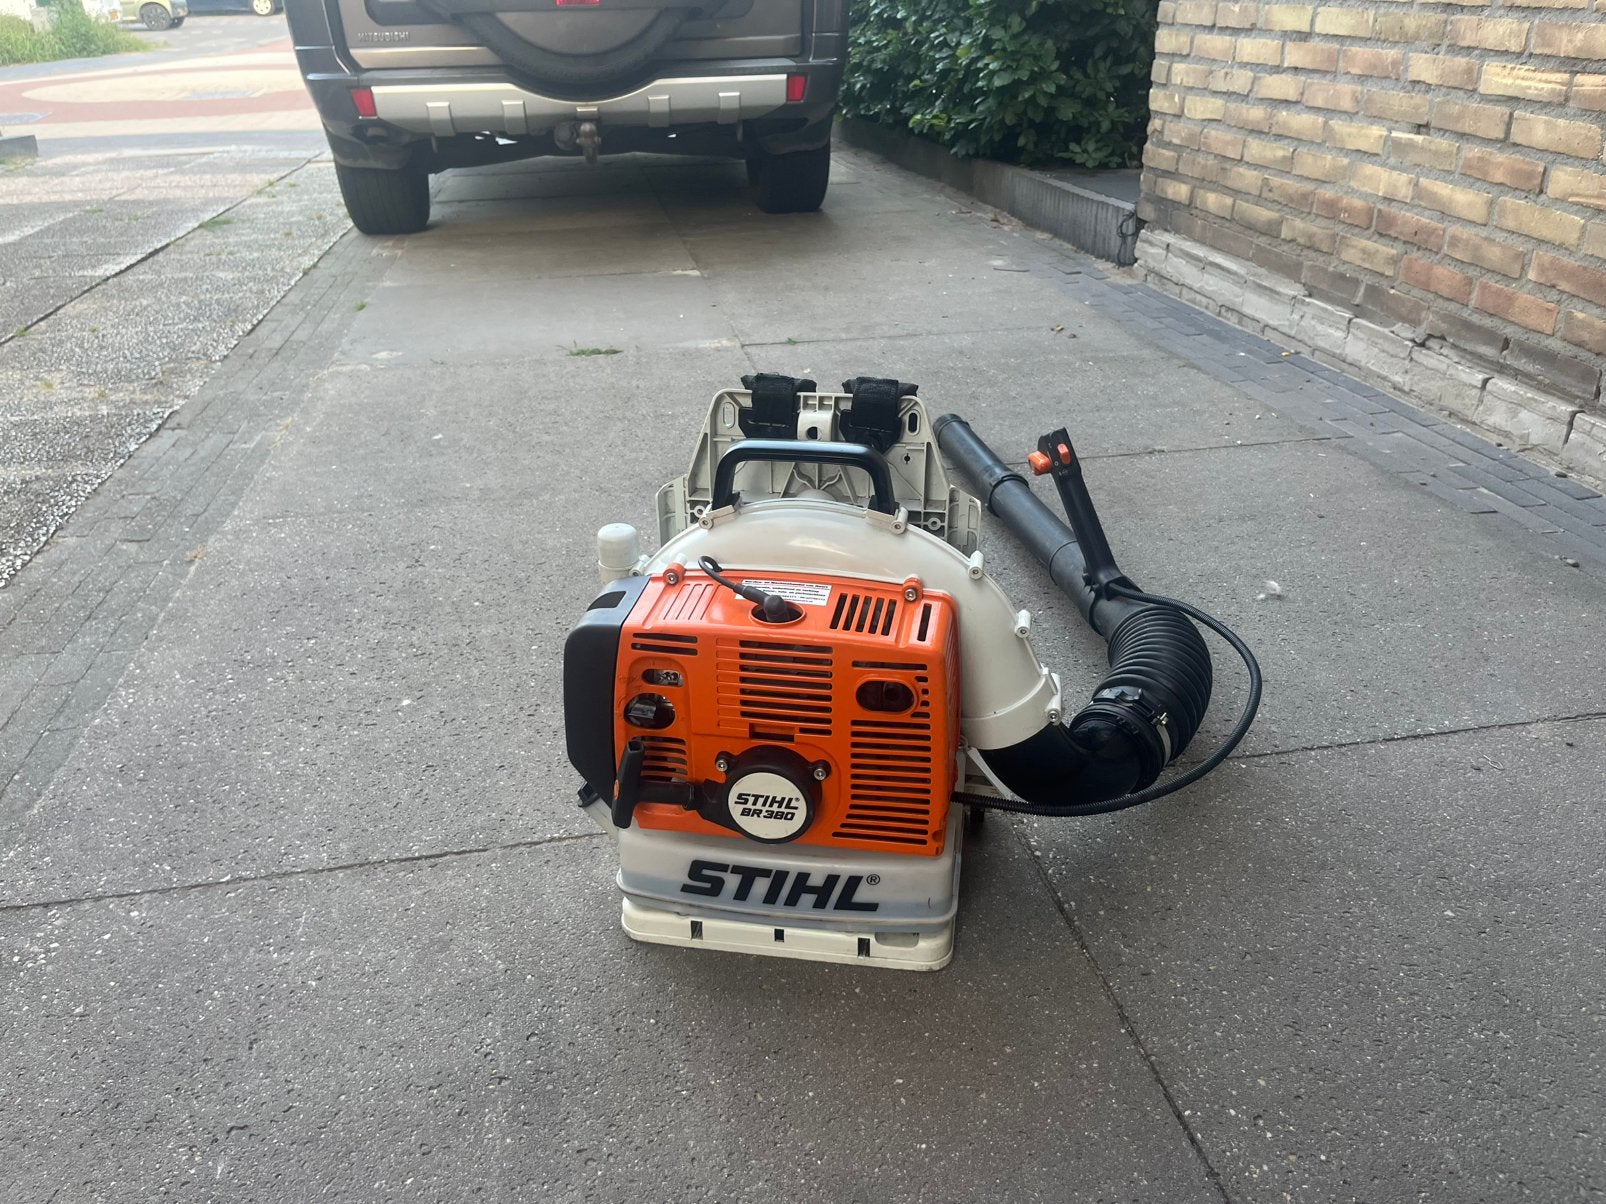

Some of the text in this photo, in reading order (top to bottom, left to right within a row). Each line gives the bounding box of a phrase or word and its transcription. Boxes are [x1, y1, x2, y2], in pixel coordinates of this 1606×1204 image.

[357, 31, 409, 42] MITSUBISHI
[740, 807, 796, 821] BR 380
